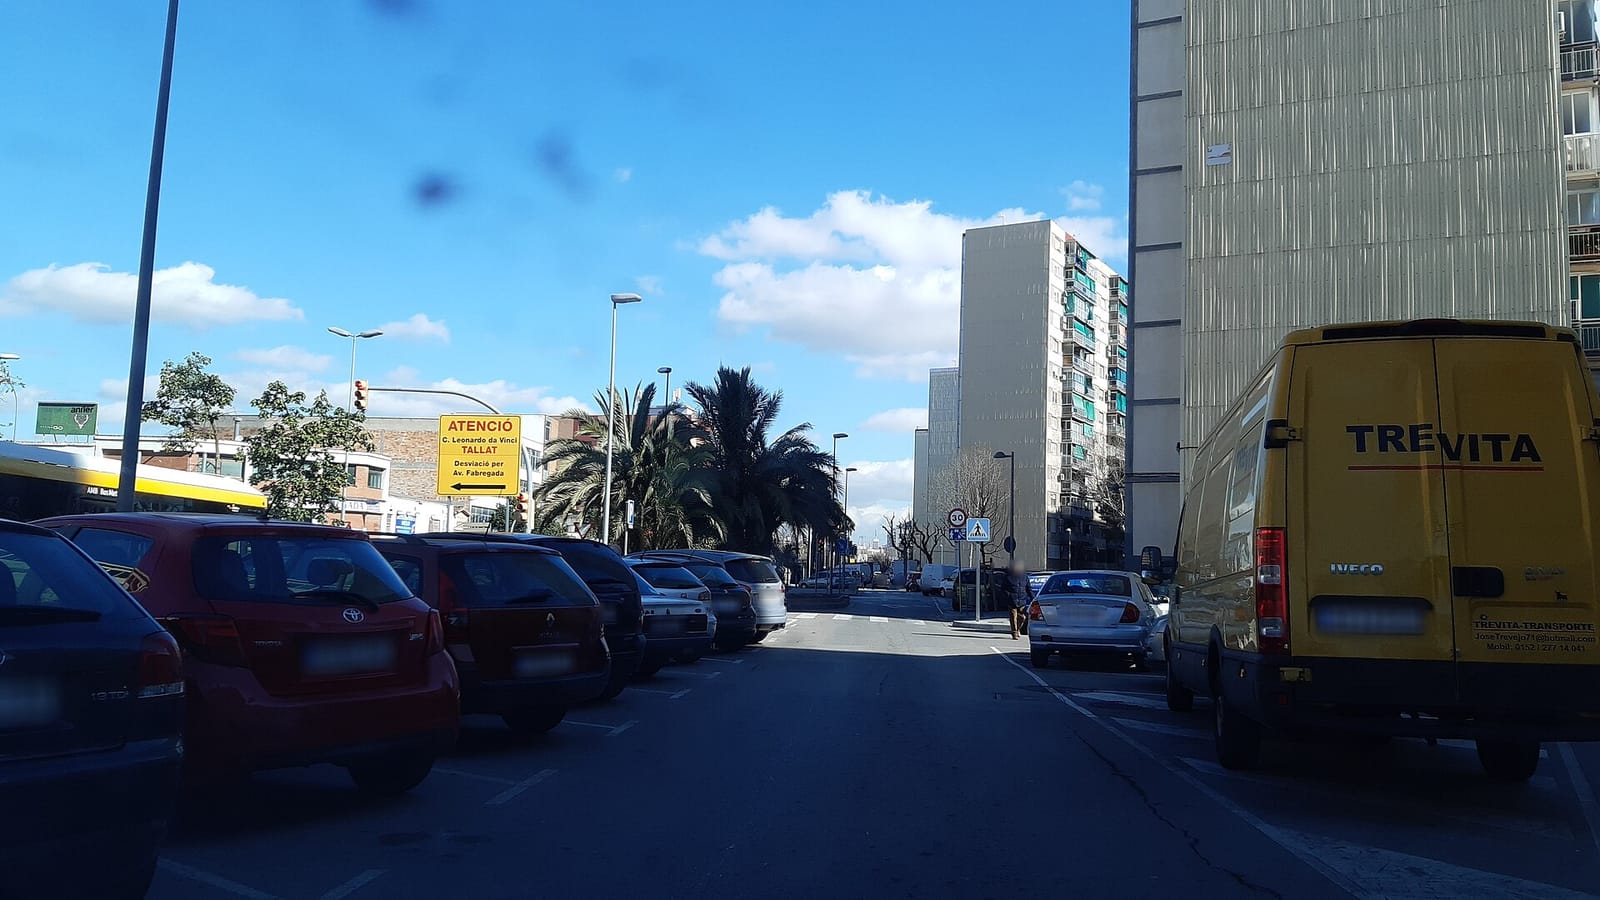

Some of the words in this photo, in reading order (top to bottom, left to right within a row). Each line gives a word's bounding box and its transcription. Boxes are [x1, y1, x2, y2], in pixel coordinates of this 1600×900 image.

[448, 418, 513, 432] ATENCIÓ
[1346, 423, 1542, 462] TREVITA
[461, 445, 498, 454] TALLAT
[466, 469, 504, 478] Fabregada
[951, 514, 964, 522] 30
[1329, 563, 1385, 577] IVECO
[1473, 621, 1595, 631] TREVITA-TRANSPORTE
